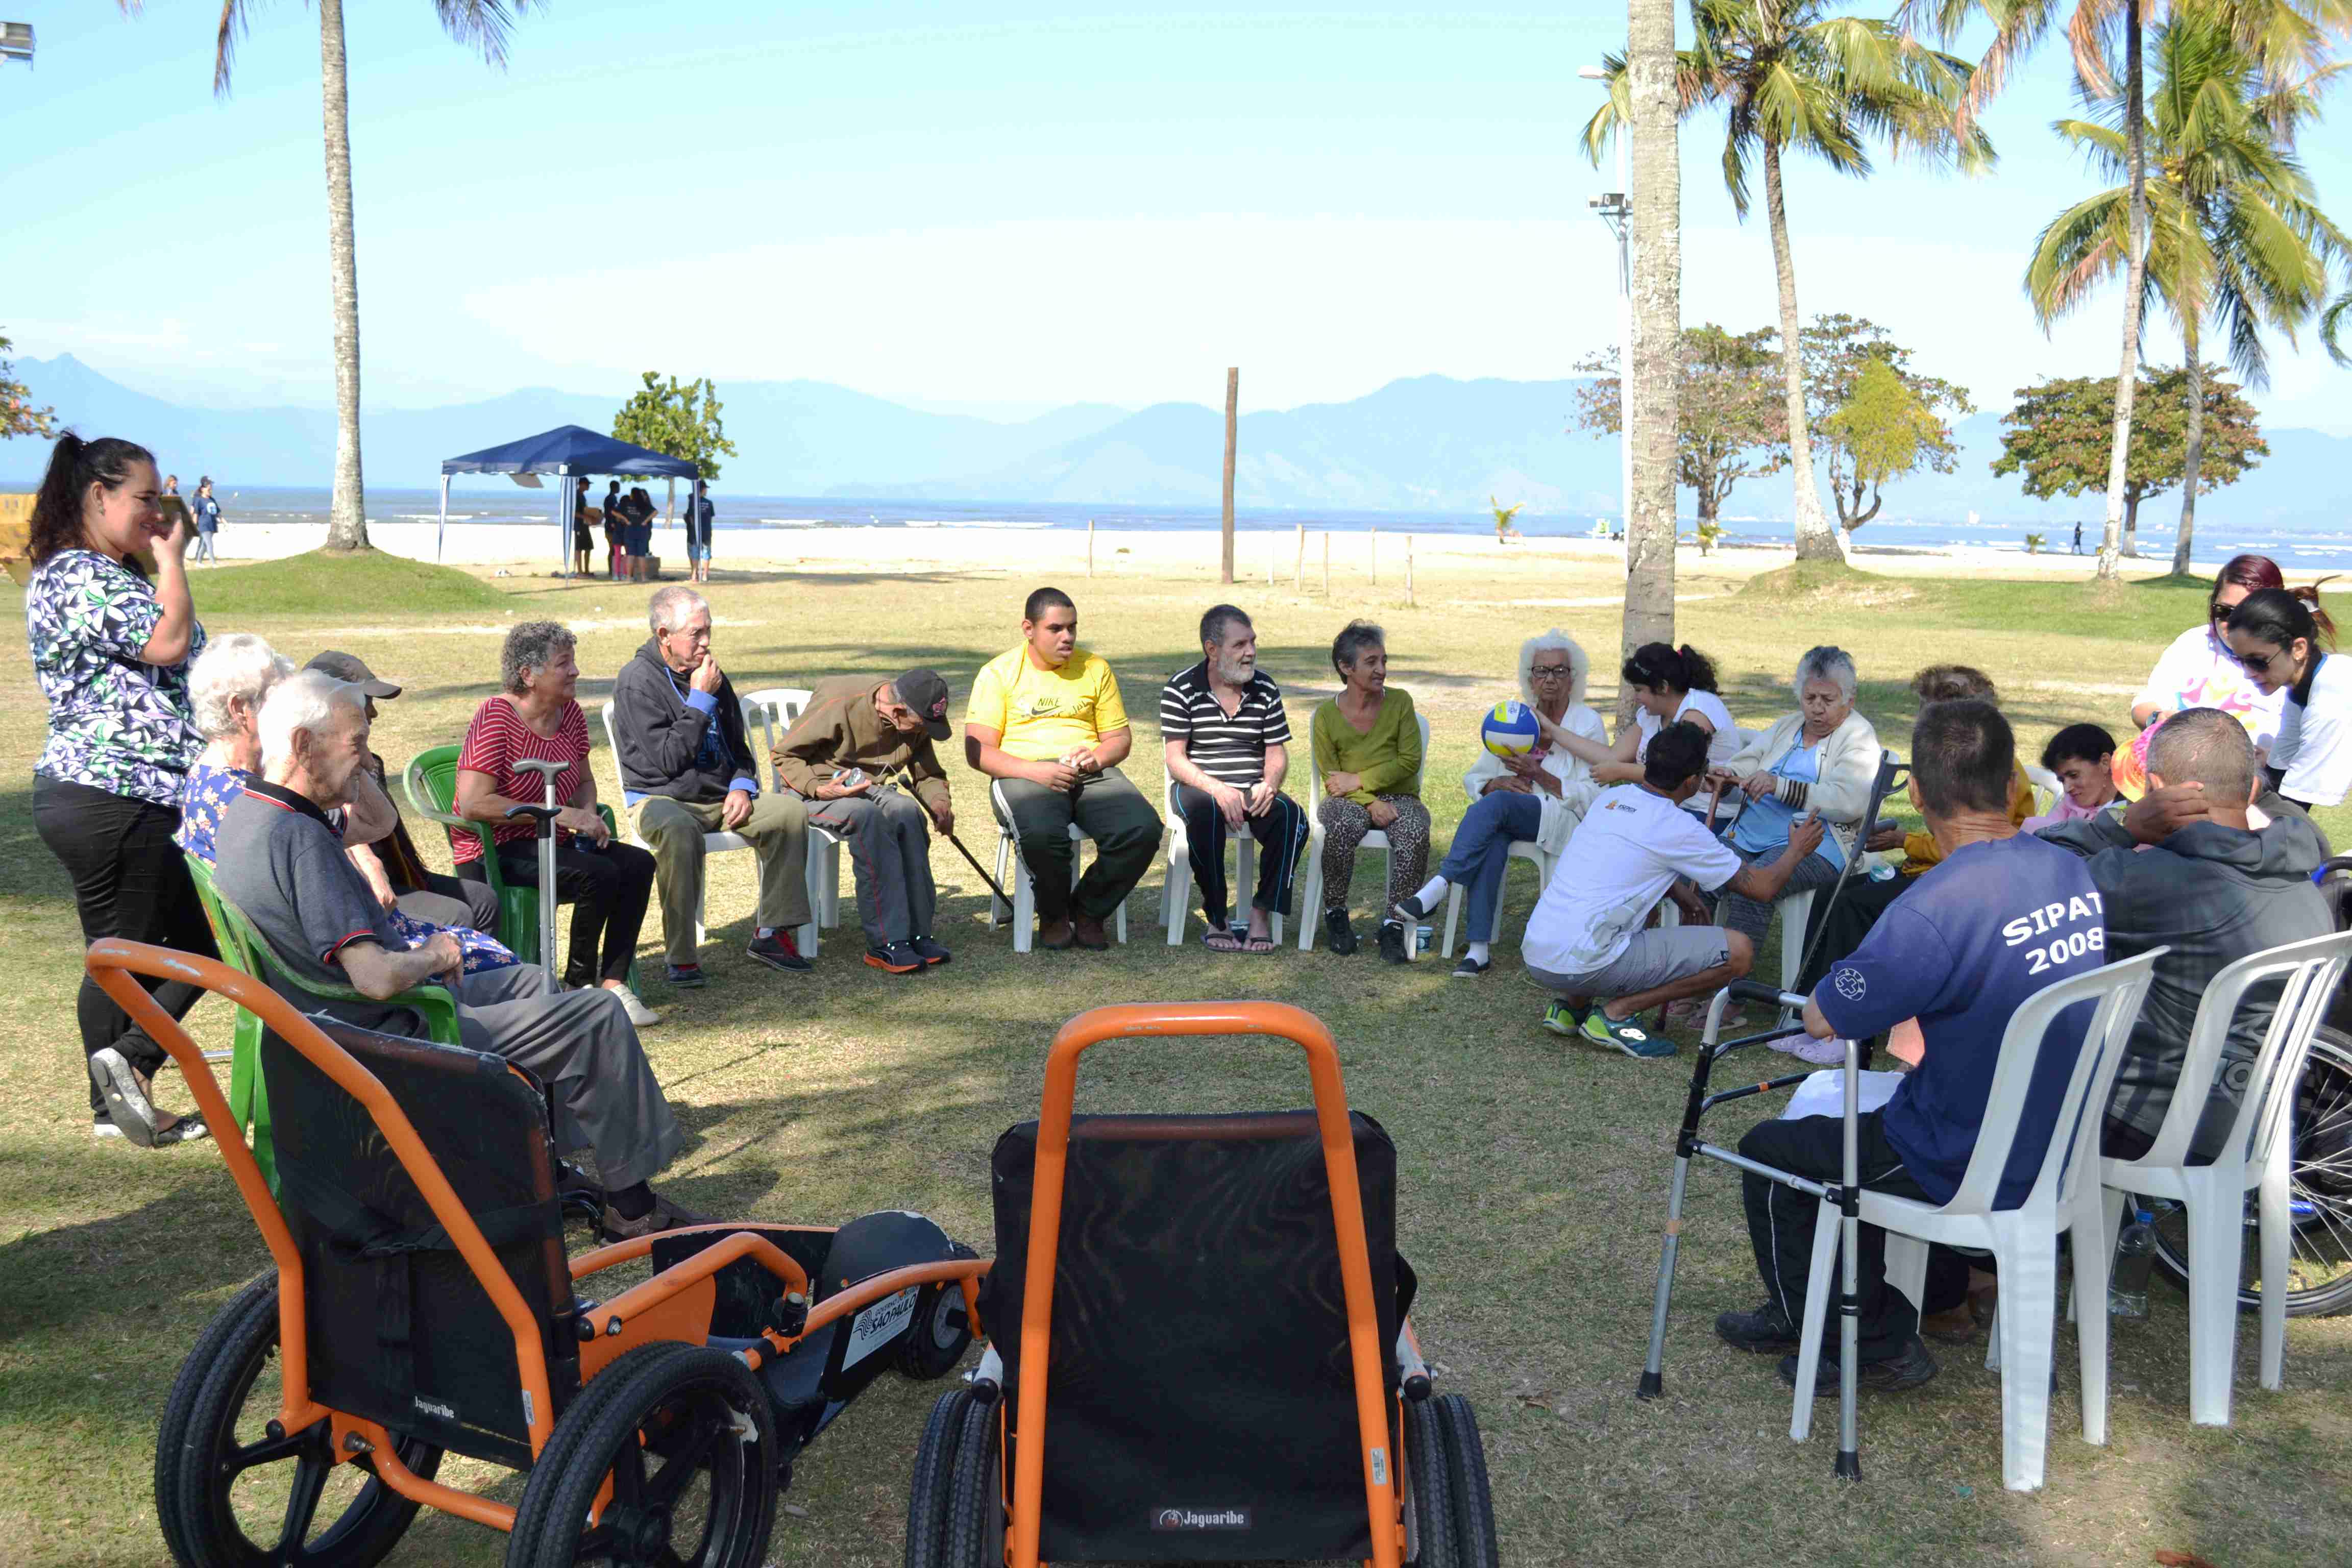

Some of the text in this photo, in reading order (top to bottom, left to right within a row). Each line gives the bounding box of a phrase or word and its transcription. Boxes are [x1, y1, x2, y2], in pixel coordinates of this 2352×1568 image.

[1038, 698, 1061, 706] NIKE
[2002, 892, 2102, 946] SIPAT
[2025, 927, 2104, 975] 2008
[889, 1293, 917, 1322] PAULO
[414, 1395, 454, 1418] Jaguaribe
[1184, 1511, 1244, 1527] Jaguaribe
